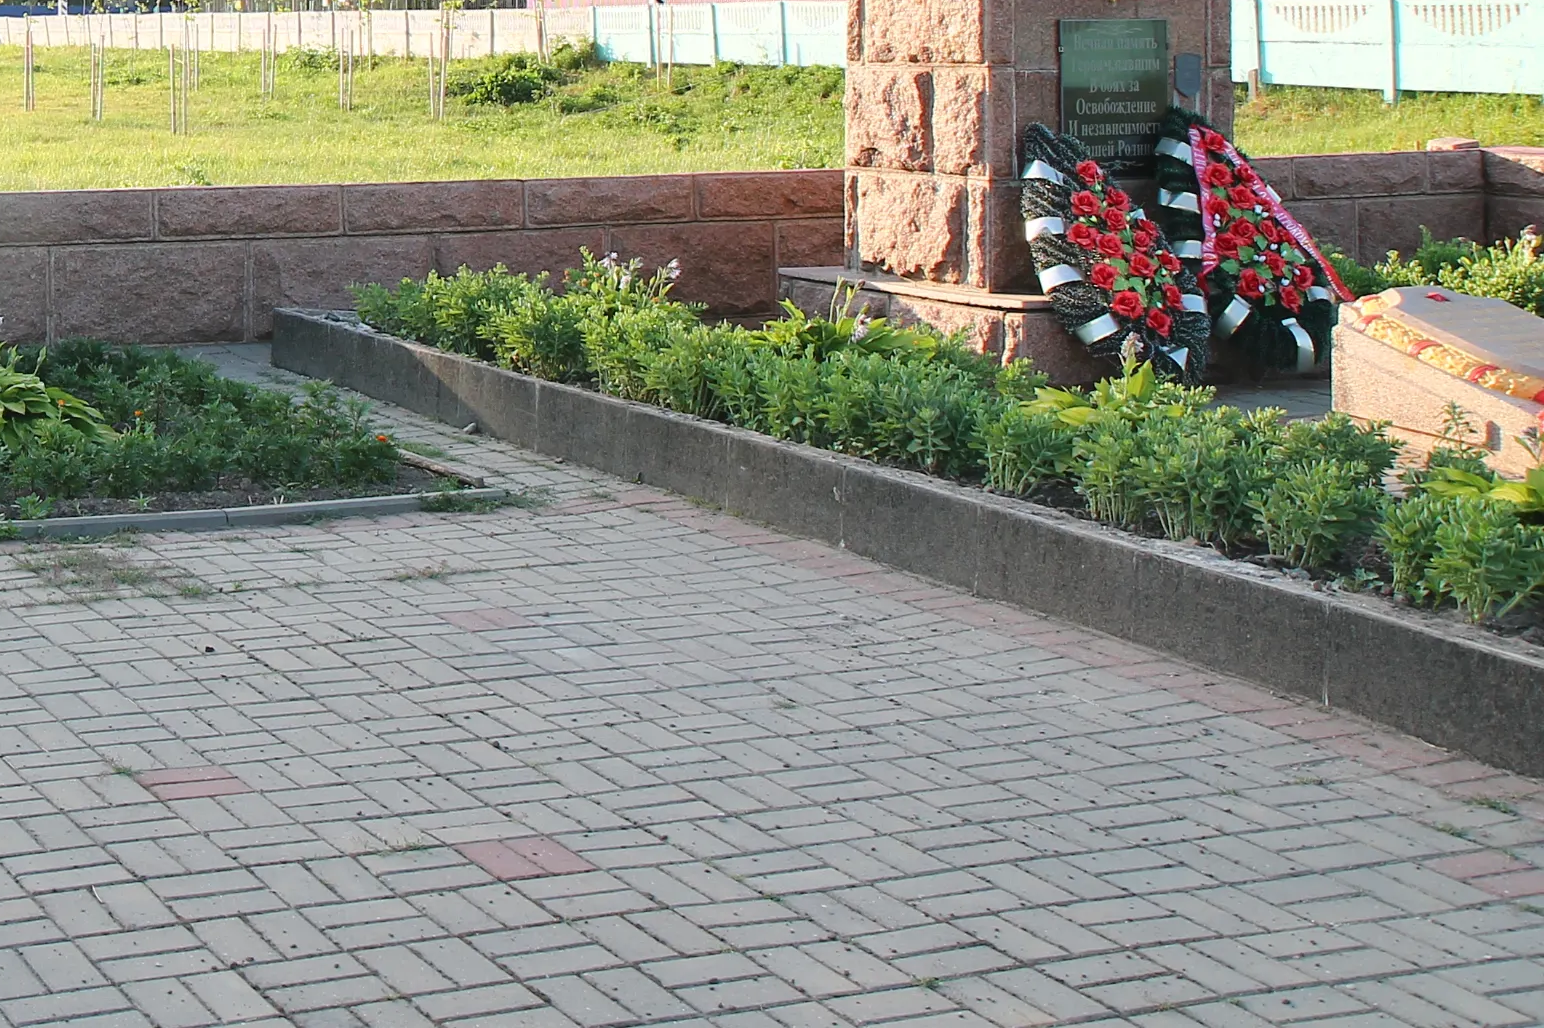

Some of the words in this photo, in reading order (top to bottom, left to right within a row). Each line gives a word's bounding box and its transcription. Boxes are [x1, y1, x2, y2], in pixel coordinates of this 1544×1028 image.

[1074, 33, 1113, 50] Вечная
[1117, 37, 1158, 49] память
[1128, 80, 1140, 92] за
[1076, 97, 1157, 115] Освобождение
[1068, 119, 1079, 136] И
[1079, 140, 1115, 157] ашей
